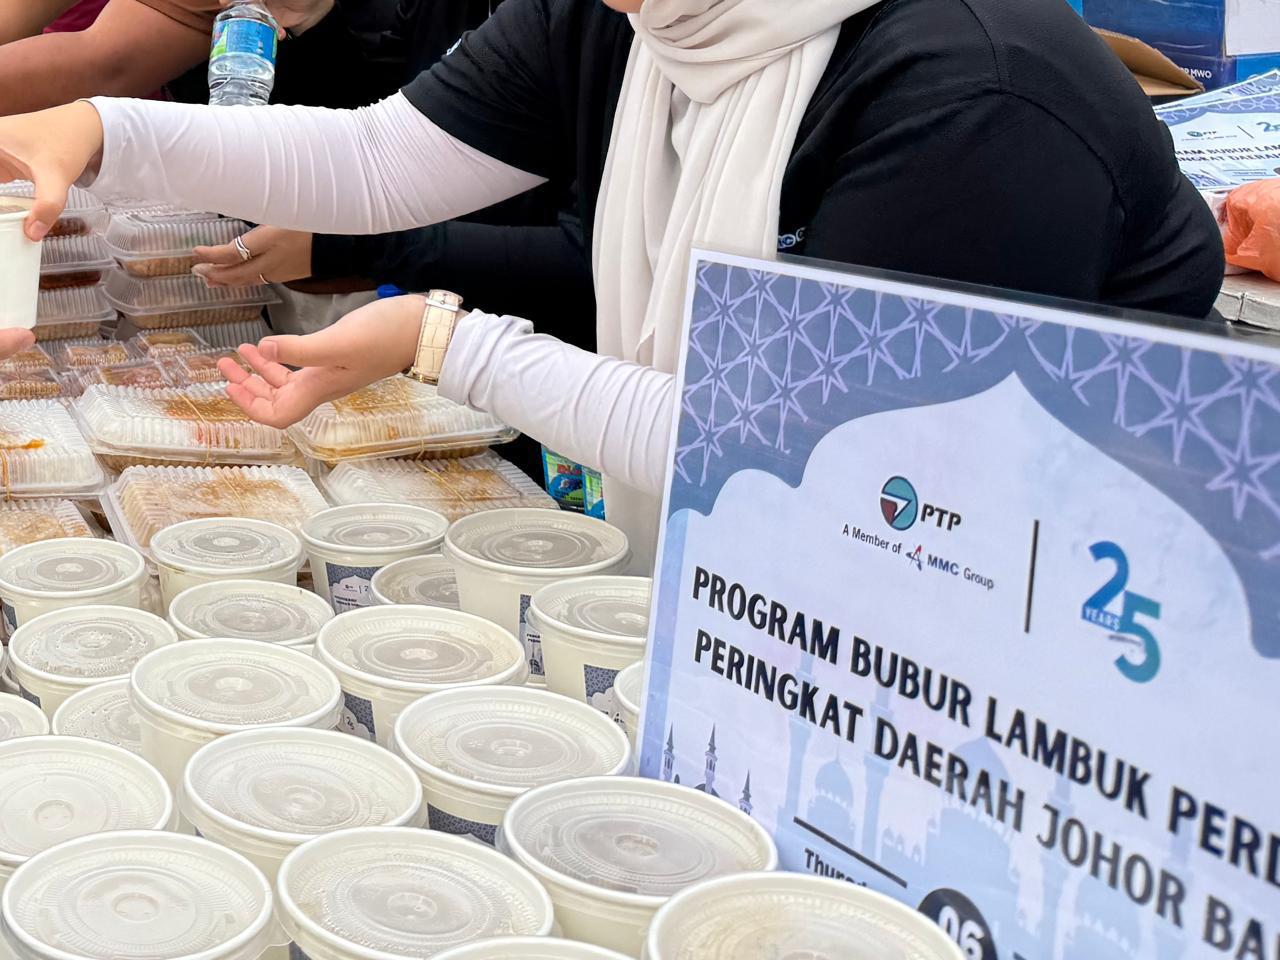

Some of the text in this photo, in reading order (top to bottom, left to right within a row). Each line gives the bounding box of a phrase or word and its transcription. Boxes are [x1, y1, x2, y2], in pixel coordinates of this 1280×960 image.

[920, 503, 962, 531] PTP
[842, 524, 995, 591] A Member of MMC Group
[1081, 540, 1162, 684] 25
[1083, 606, 1121, 632] YEARS
[692, 565, 841, 666] PROGRAM
[850, 635, 973, 728] BUBUR
[985, 695, 1152, 821] LAMBUK
[694, 628, 1280, 960] PERINGKAT DAERAH JOHOR BA
[804, 847, 868, 888] Thur
[938, 904, 985, 960] 06
